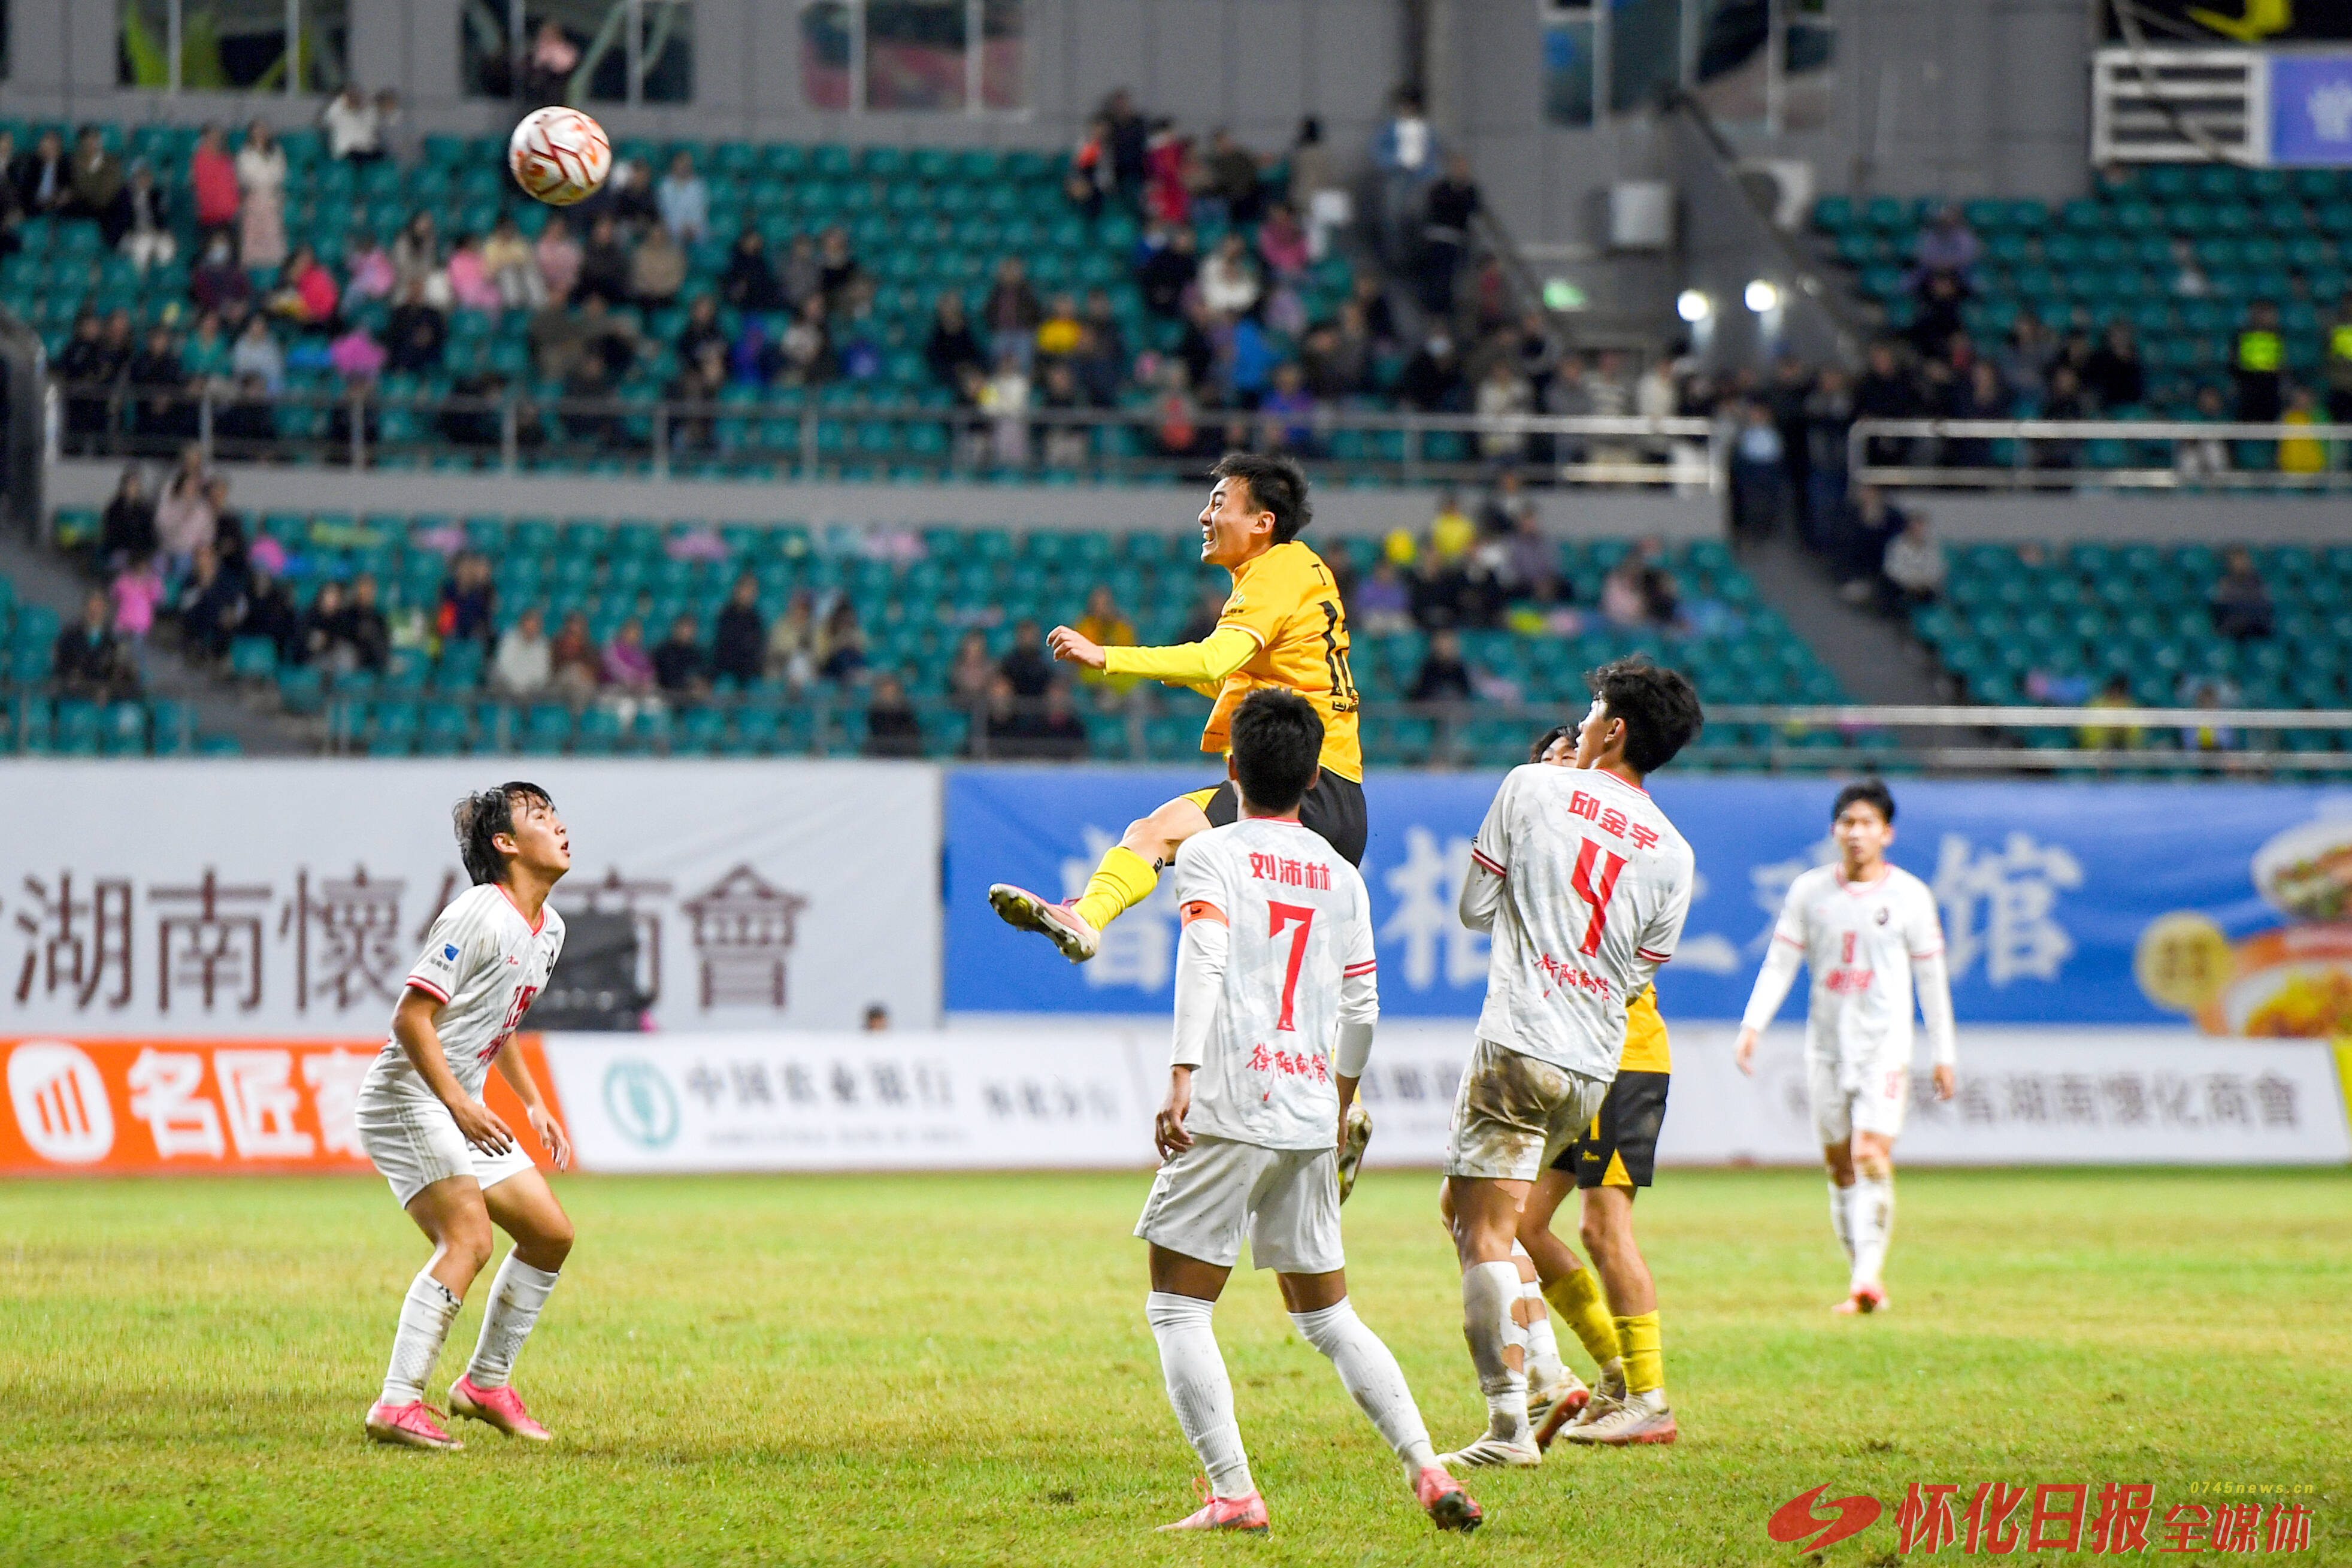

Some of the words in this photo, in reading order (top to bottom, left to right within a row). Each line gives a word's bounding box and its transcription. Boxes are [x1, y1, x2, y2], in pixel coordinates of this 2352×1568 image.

[1567, 790, 1659, 849] 邱金宇
[1248, 851, 1331, 891] 刘沛林
[1570, 836, 1629, 958] 4
[1266, 899, 1316, 1031] 7
